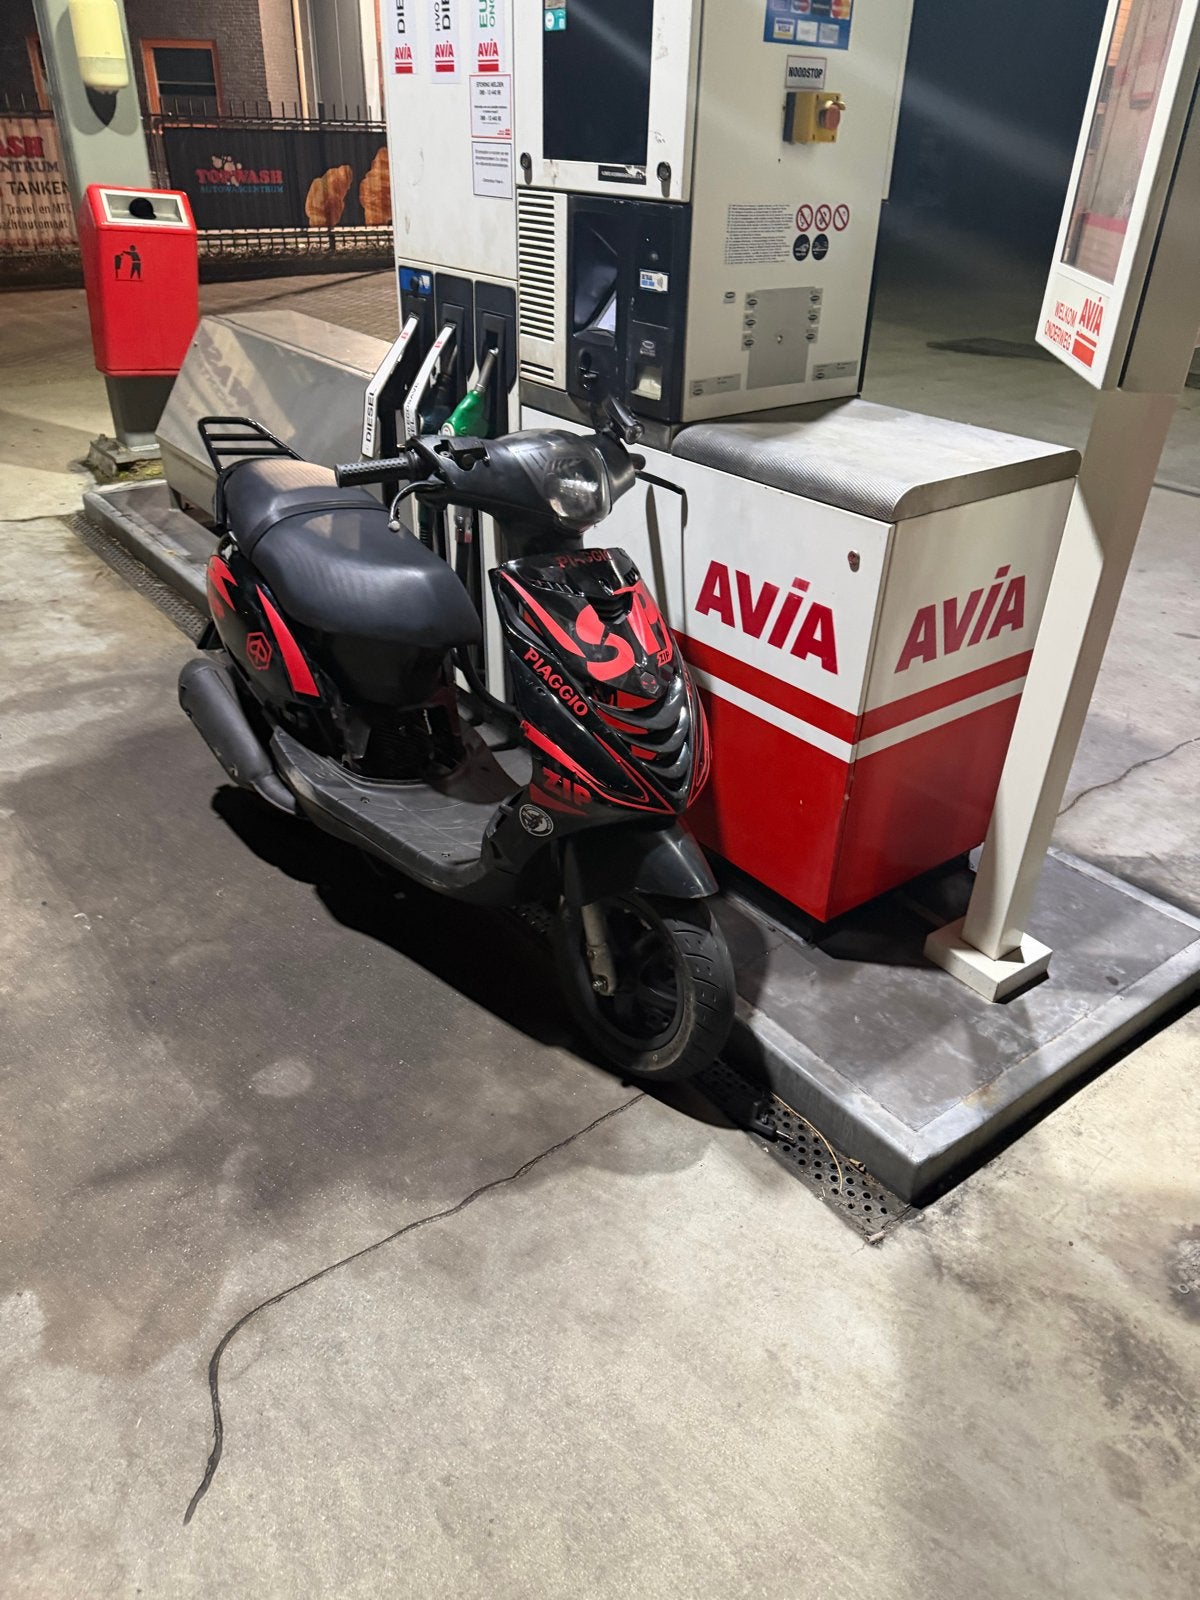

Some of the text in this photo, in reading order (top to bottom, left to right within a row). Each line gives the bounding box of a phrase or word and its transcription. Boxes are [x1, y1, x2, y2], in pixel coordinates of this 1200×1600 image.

[787, 66, 824, 79] NOODSTOP
[1078, 296, 1104, 336] AVIA
[365, 388, 377, 443] DIESEL
[694, 560, 839, 675] AVIA
[894, 564, 1026, 674] AVIA
[658, 650, 670, 663] ZIP
[523, 647, 590, 718] PIAGGIO
[543, 766, 593, 806] ZIP
